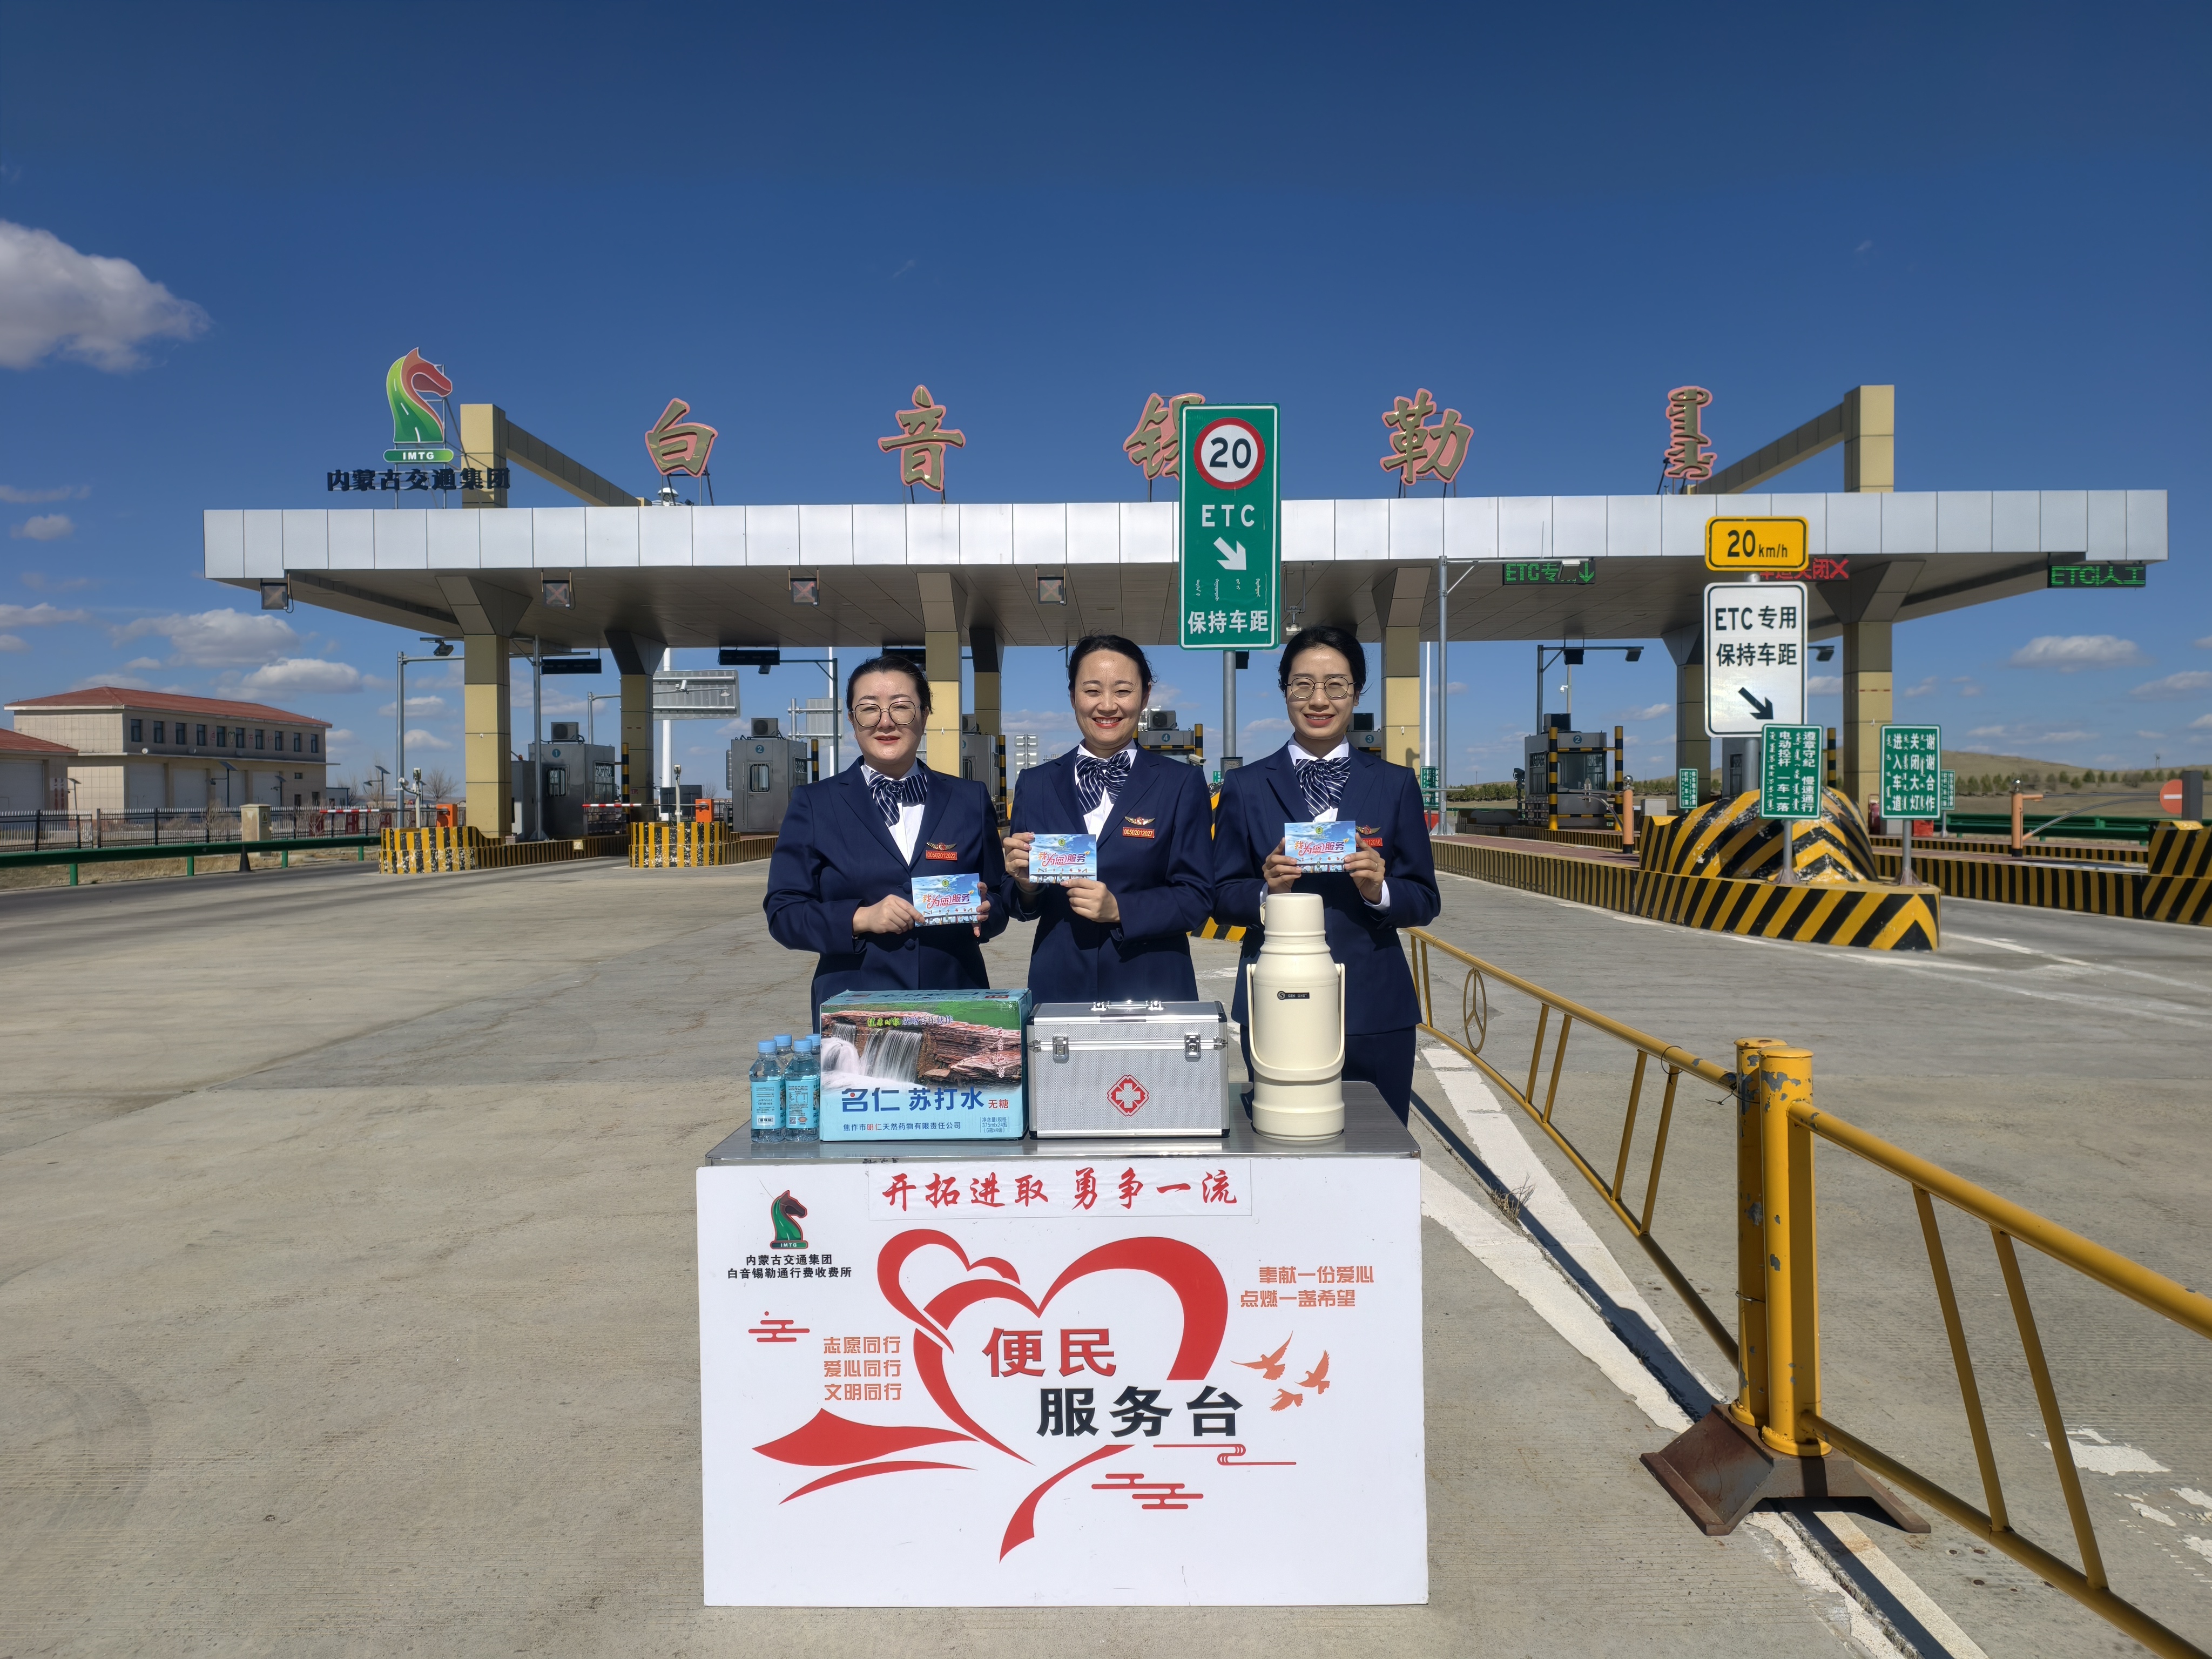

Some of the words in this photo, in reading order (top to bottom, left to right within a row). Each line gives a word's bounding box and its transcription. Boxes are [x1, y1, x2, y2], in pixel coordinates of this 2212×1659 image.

[402, 451, 435, 460] IMTG
[1209, 436, 1252, 468] 20
[327, 467, 511, 491] 内蒙古交通集团
[1202, 504, 1255, 527] ETC
[1506, 563, 1576, 582] ETC专
[1188, 610, 1269, 634] 保持车距
[1716, 643, 1797, 666] 保持车距
[1892, 733, 1903, 811] 进入车道
[1910, 733, 1920, 811] 关闭大灯
[1926, 733, 1936, 812] 谢谢合作
[1124, 828, 1153, 837] 00502012027
[1294, 841, 1345, 857] 我为您服务
[1038, 852, 1087, 867] 我为您服务
[922, 893, 970, 909] 我为您服务
[988, 1099, 1009, 1109] 无糖
[843, 1122, 961, 1131] 焦作市明仁天然药物有限责任公司
[882, 1172, 1048, 1211] 开拓进取
[1072, 1167, 1237, 1210] 勇争一流
[746, 1254, 832, 1266] 内蒙古交通集团
[728, 1267, 852, 1279] 白音锡勒通行费收费所
[1259, 1265, 1374, 1284] 奉献一份爱心
[1240, 1290, 1355, 1308] 点燃一盏希望
[823, 1336, 901, 1354] 志愿同行
[981, 1326, 1117, 1378] 便民
[823, 1360, 901, 1377] 爱心同行
[824, 1384, 902, 1401] 文明同行
[1036, 1385, 1244, 1438] 服务台
